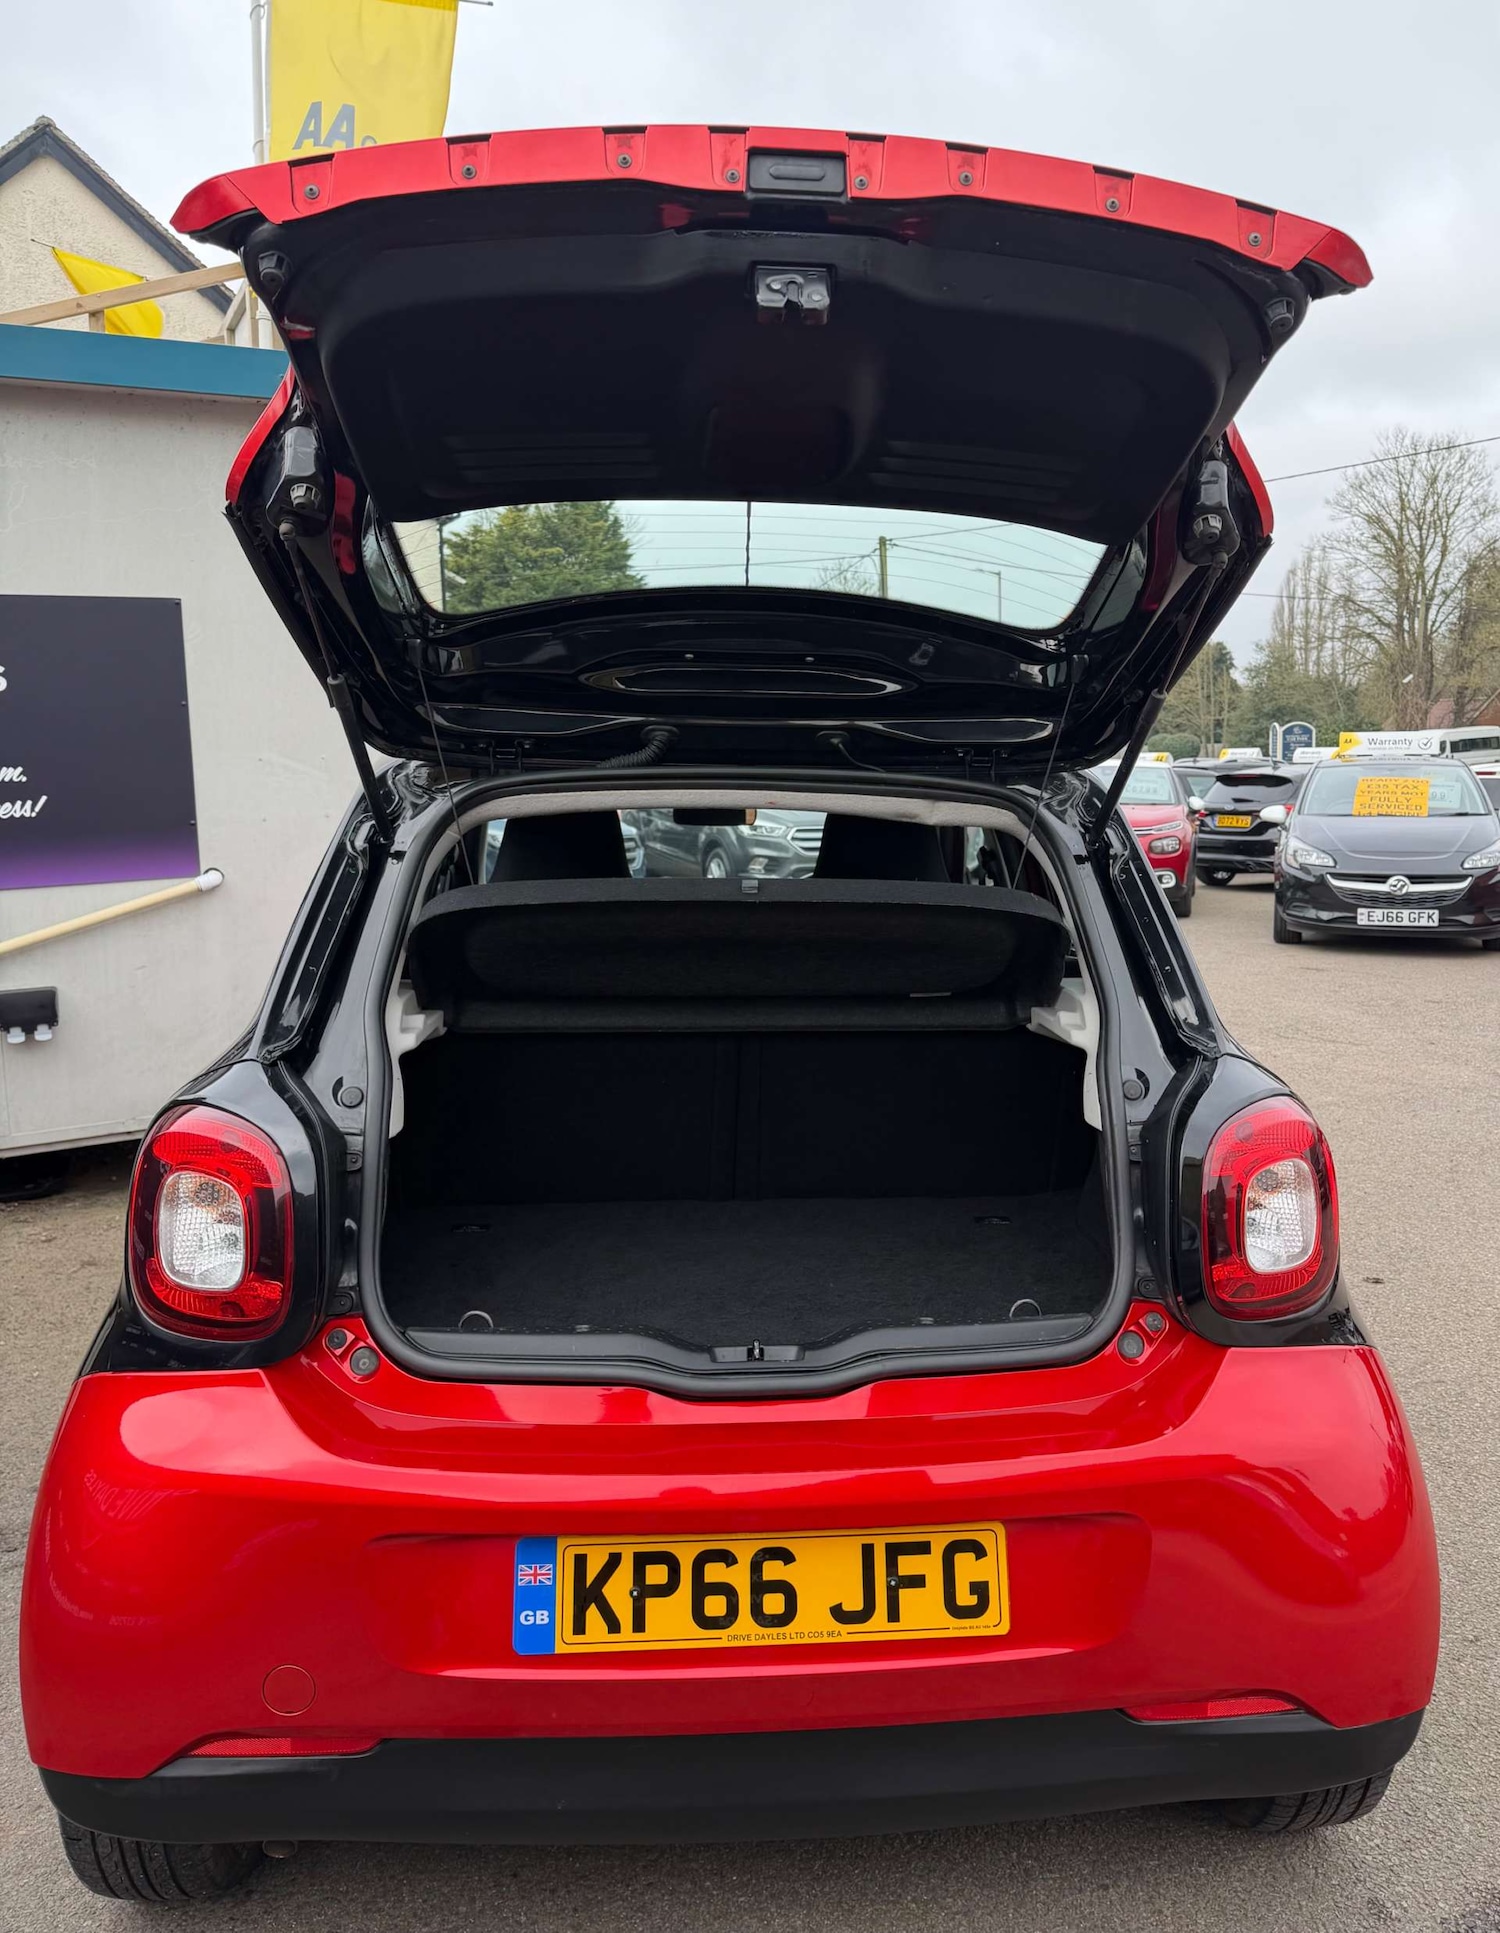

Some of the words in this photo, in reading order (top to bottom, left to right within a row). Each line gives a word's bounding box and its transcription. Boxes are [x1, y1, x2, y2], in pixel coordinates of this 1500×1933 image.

[292, 101, 355, 149] AA
[1367, 737, 1413, 747] Warranty
[1359, 803, 1423, 811] SERVICED
[1367, 910, 1404, 923] EJ66
[1408, 911, 1436, 924] GFK
[572, 1546, 798, 1636] KP66
[829, 1538, 990, 1625] JFG
[519, 1610, 550, 1626] GB
[727, 1633, 752, 1642] DRIVE
[754, 1632, 787, 1641] DAYLES
[789, 1631, 805, 1640] LTD
[827, 1630, 843, 1638] 9EA
